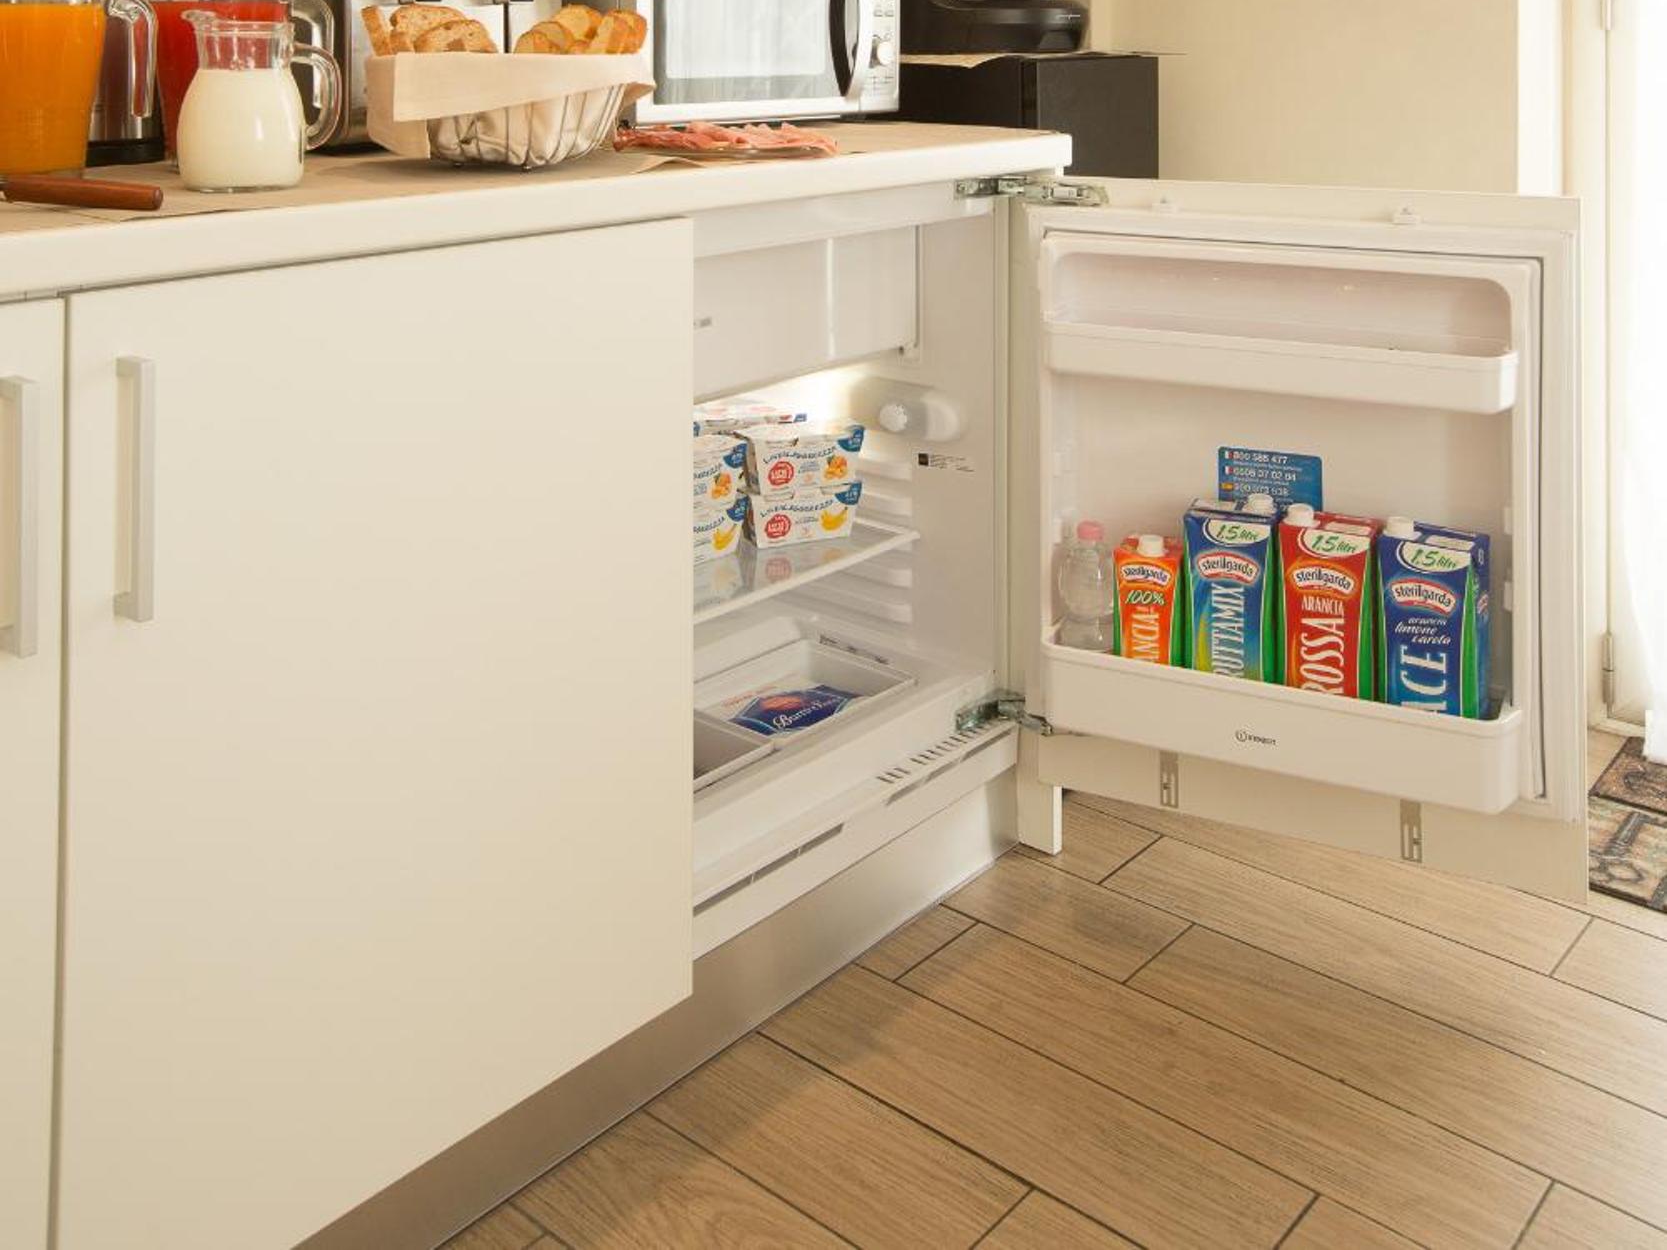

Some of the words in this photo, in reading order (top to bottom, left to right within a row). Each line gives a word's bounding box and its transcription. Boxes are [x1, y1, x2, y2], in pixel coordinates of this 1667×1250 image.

[1216, 524, 1239, 539] 1.5
[1311, 534, 1339, 552] 1.5
[1201, 556, 1254, 578] sterilgarda
[1410, 548, 1438, 567] 1.5
[1296, 567, 1351, 591] sterilgarda
[1125, 589, 1166, 606] 100%
[1301, 595, 1345, 616] ARANCIA
[1394, 584, 1452, 608] sterilgarda
[1130, 611, 1160, 663] ANCIA
[1211, 582, 1246, 677] RUTTAMIX
